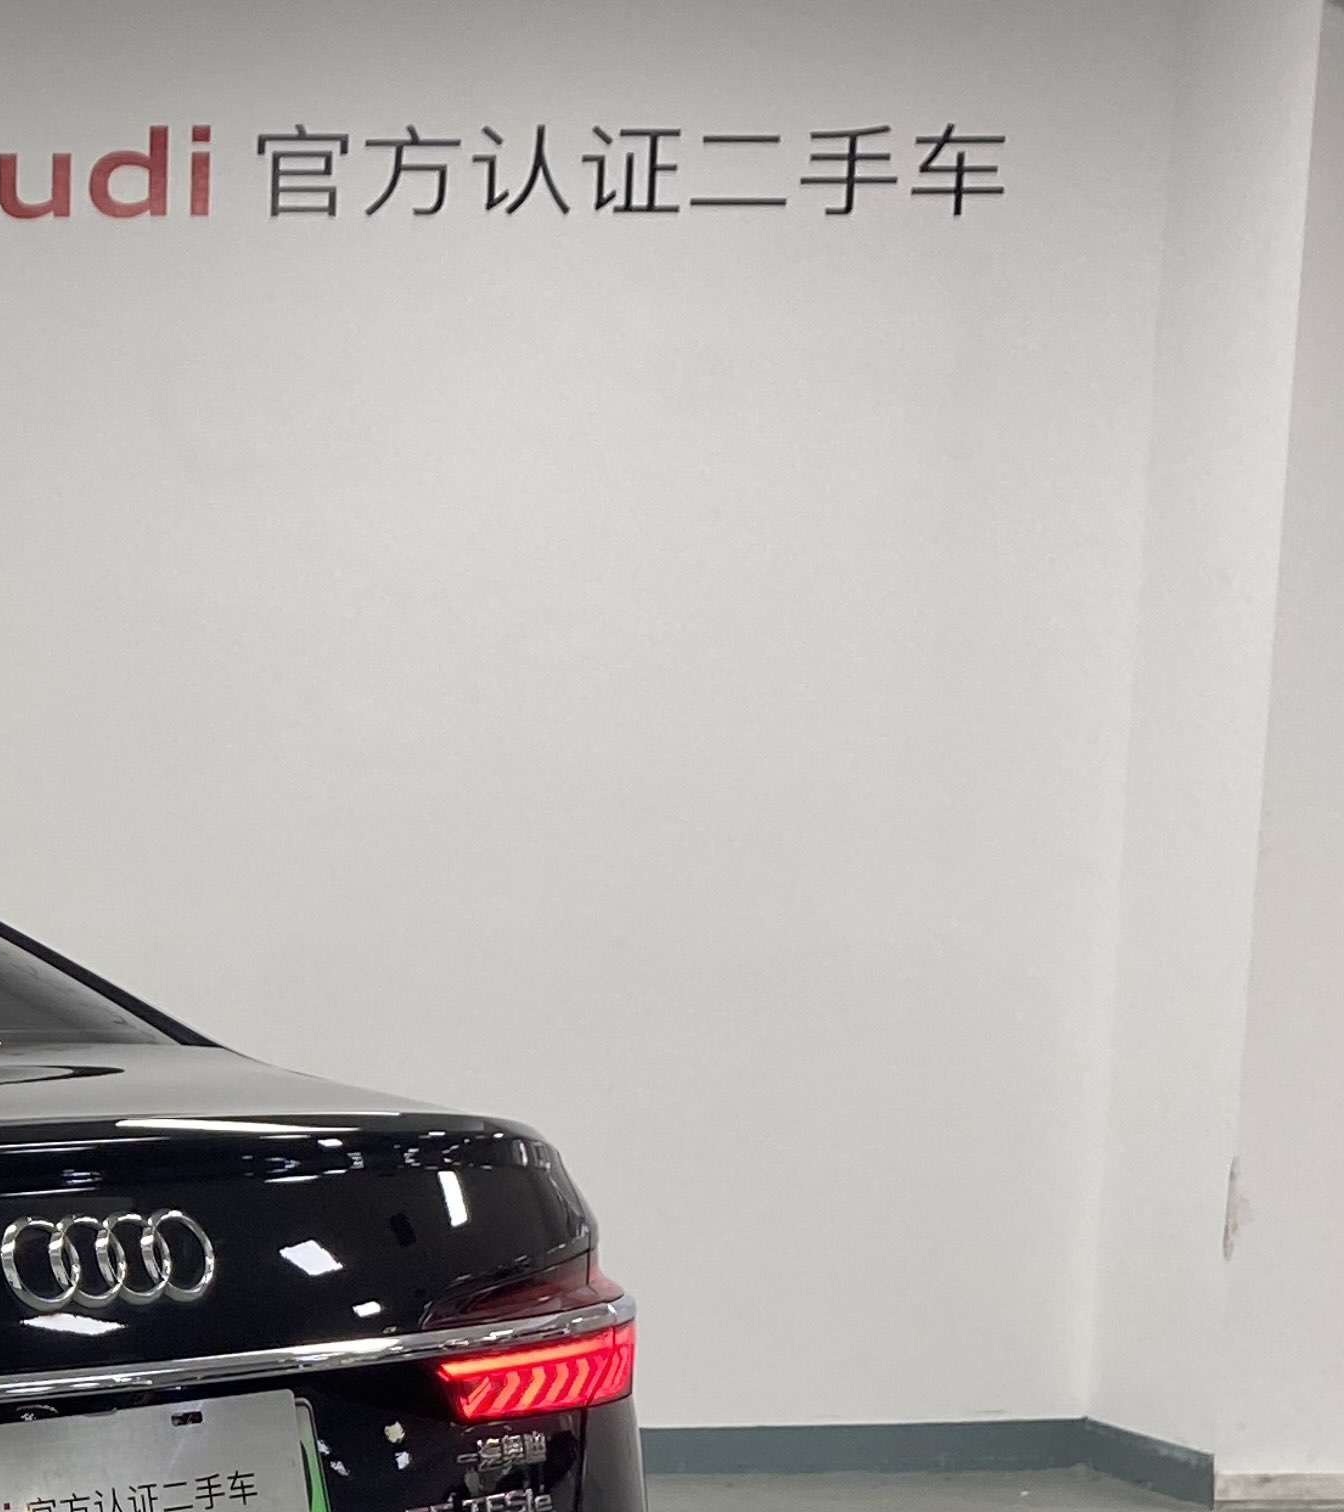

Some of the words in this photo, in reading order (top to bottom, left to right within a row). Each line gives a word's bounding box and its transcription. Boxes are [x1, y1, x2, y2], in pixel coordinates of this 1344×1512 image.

[256, 123, 1006, 217] 官方认证二手车
